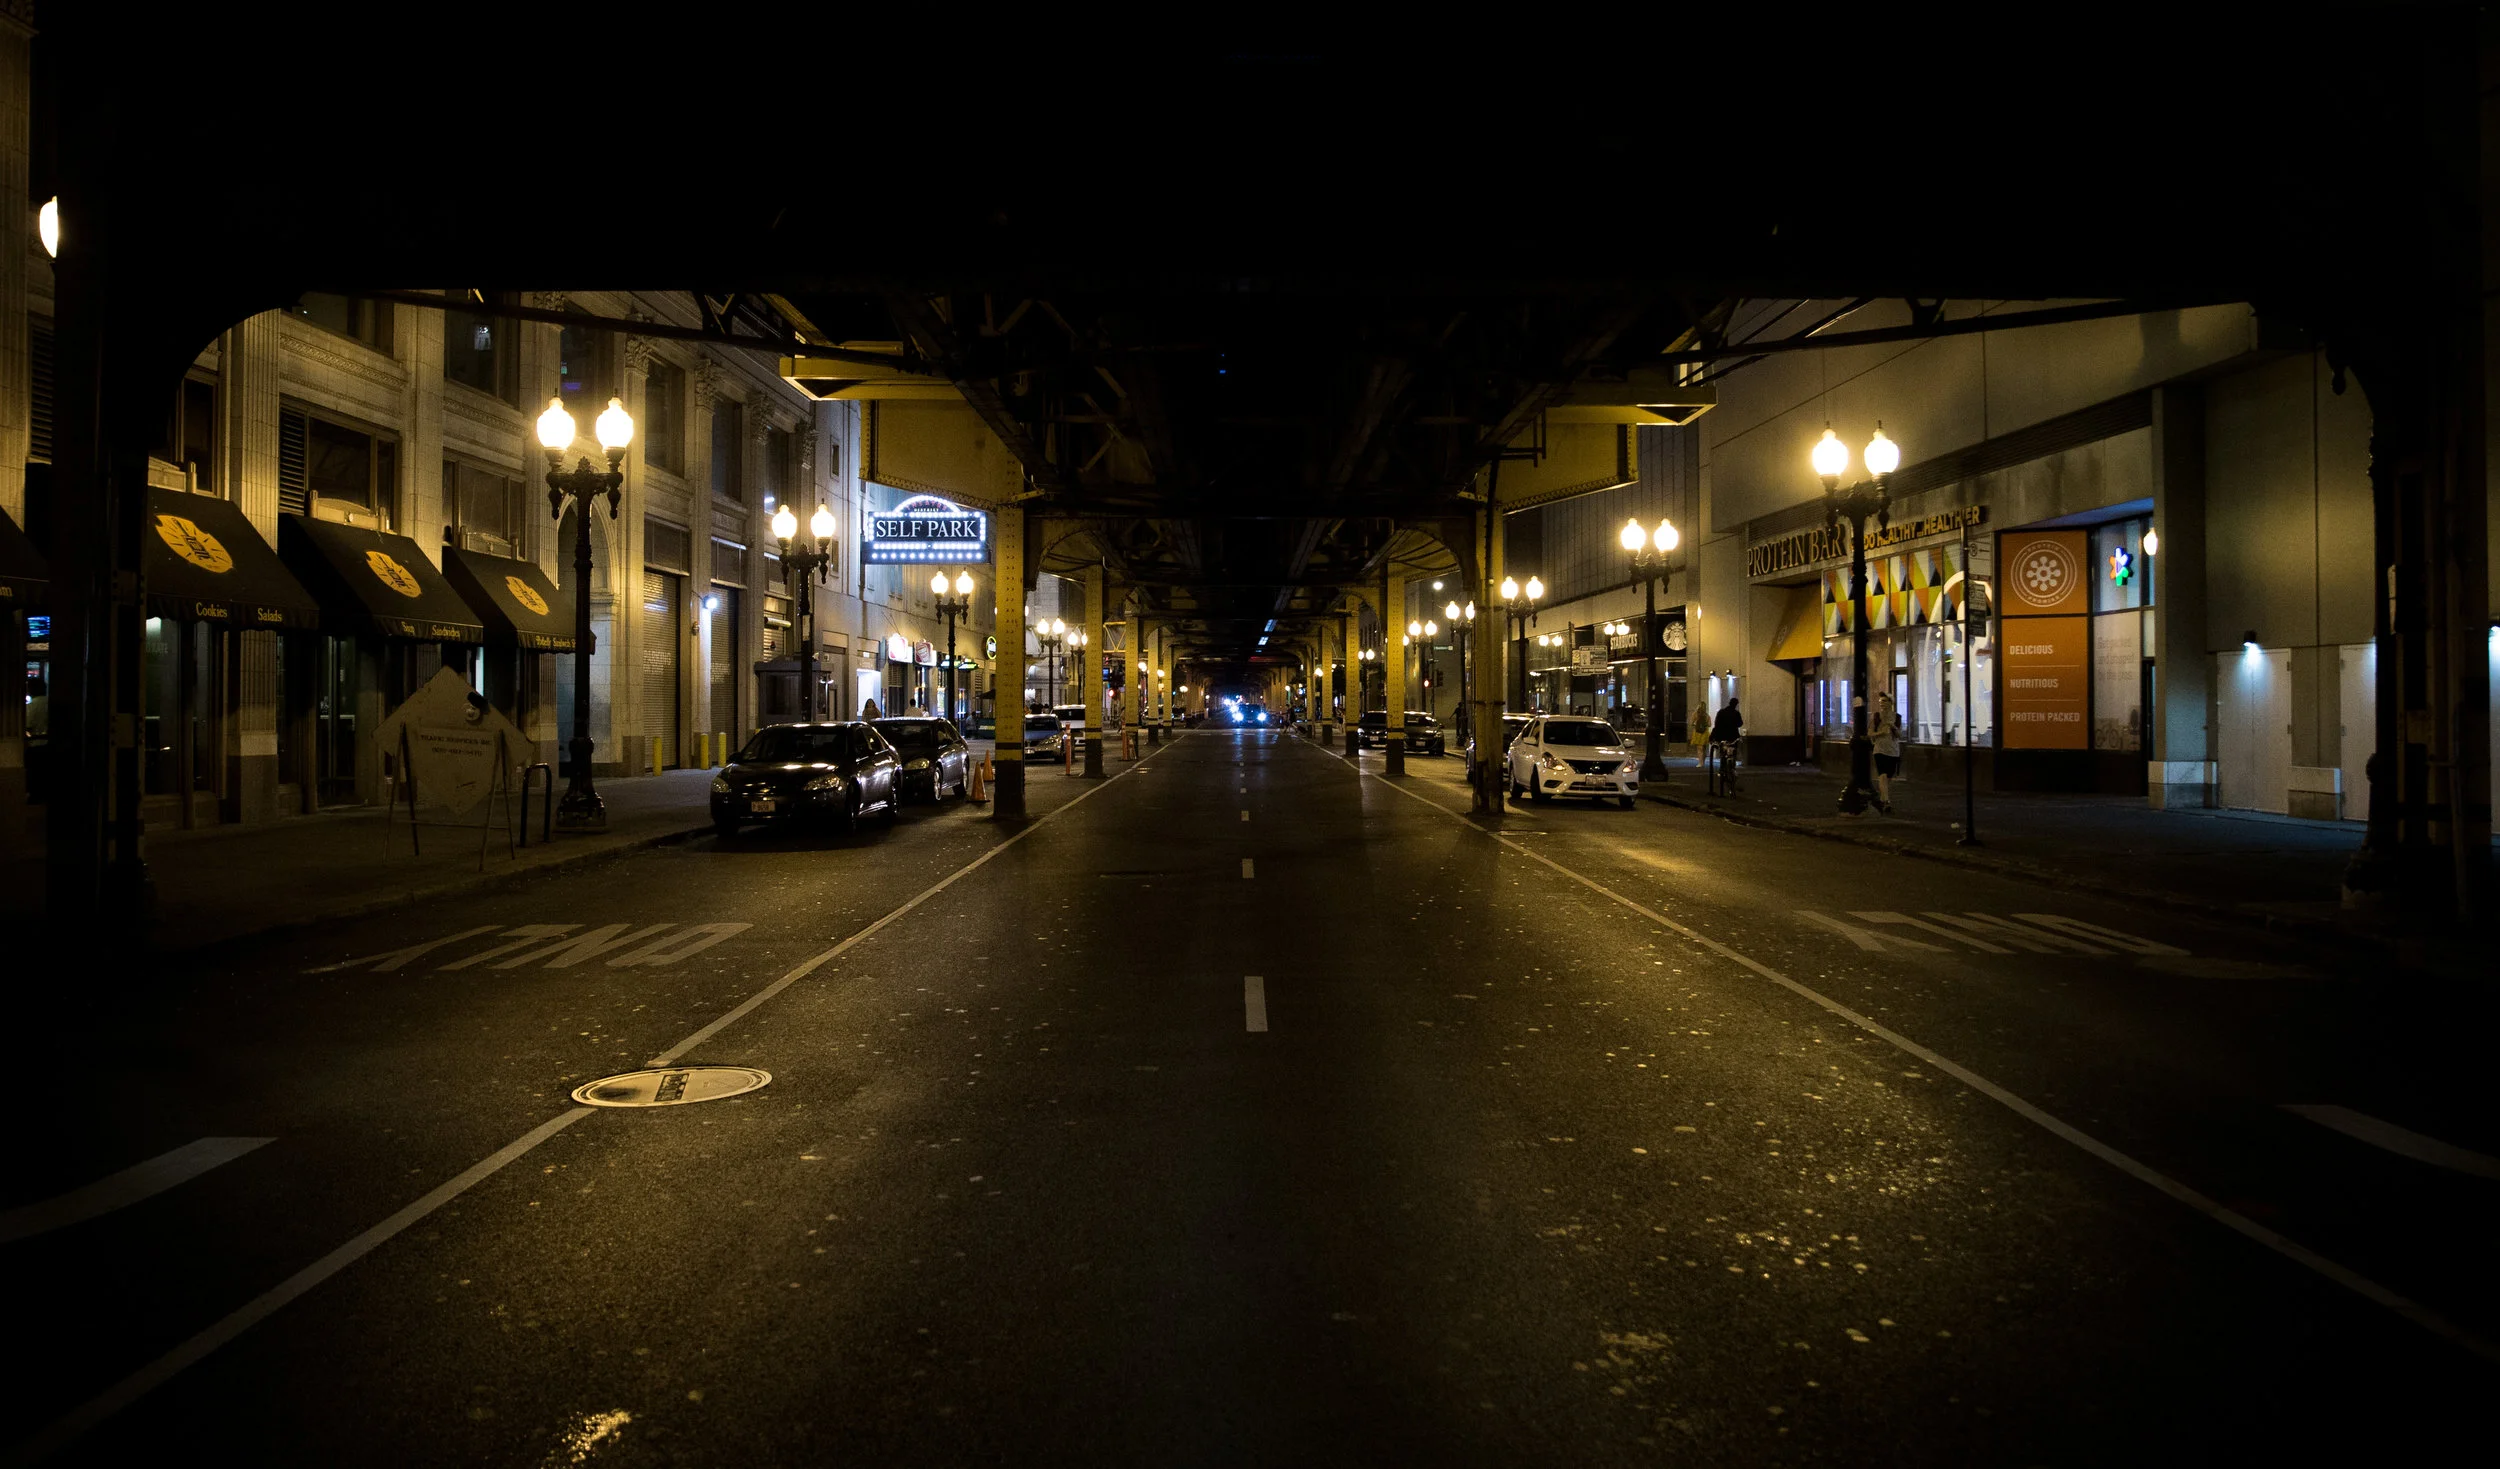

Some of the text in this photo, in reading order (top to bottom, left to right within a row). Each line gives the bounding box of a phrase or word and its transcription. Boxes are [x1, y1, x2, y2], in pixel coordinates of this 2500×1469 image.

[876, 520, 977, 538] SELF PARK
[1747, 524, 1842, 577] PROTEIN BAR
[195, 602, 283, 622] Cookies Salads
[1610, 633, 1638, 651] STARBUCKS
[2009, 644, 2053, 655] DELICIOUS
[2009, 678, 2059, 688] NUTRITIOUS
[2010, 712, 2080, 722] PROTEIN PACKED
